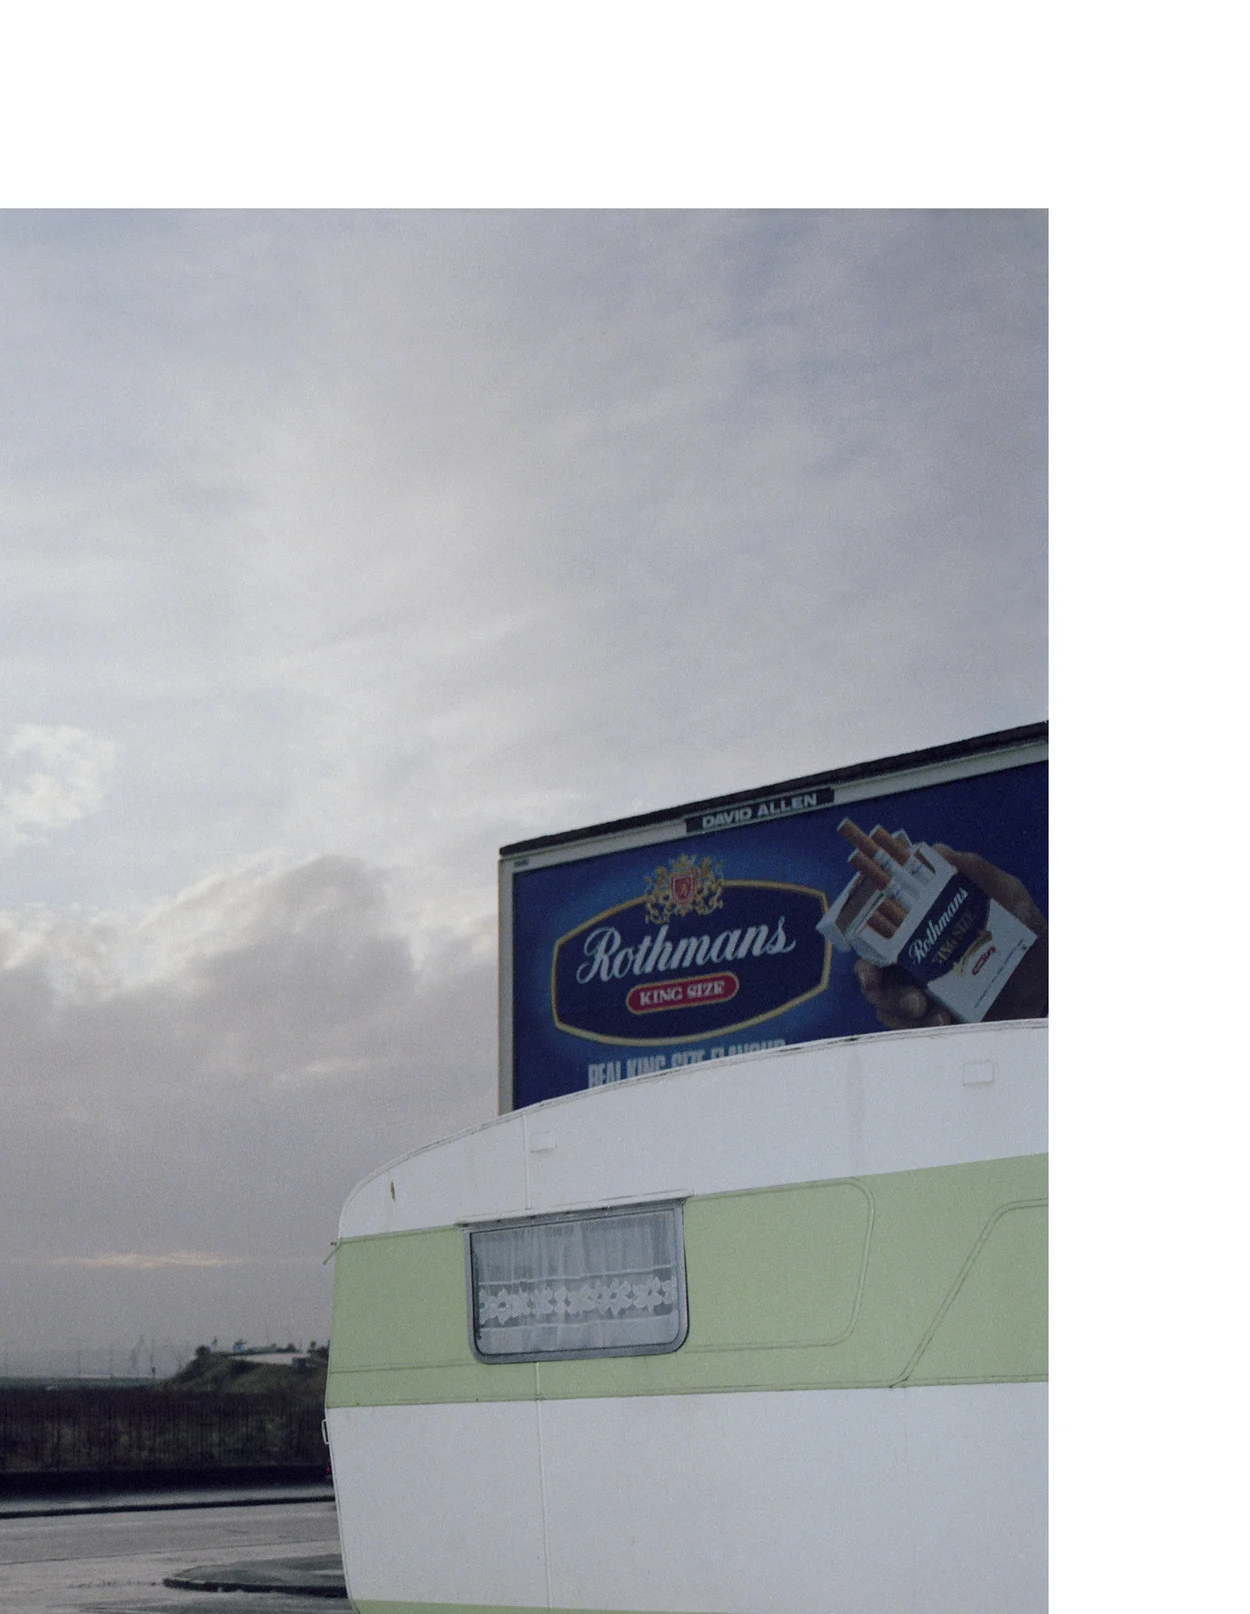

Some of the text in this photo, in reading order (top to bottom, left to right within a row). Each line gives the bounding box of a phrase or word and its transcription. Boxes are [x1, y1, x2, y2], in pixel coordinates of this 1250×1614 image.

[701, 793, 817, 829] DAVID ALLEN
[576, 915, 796, 984] Rothmans
[908, 887, 969, 965] Rothmans
[639, 979, 726, 1006] KING SIZE
